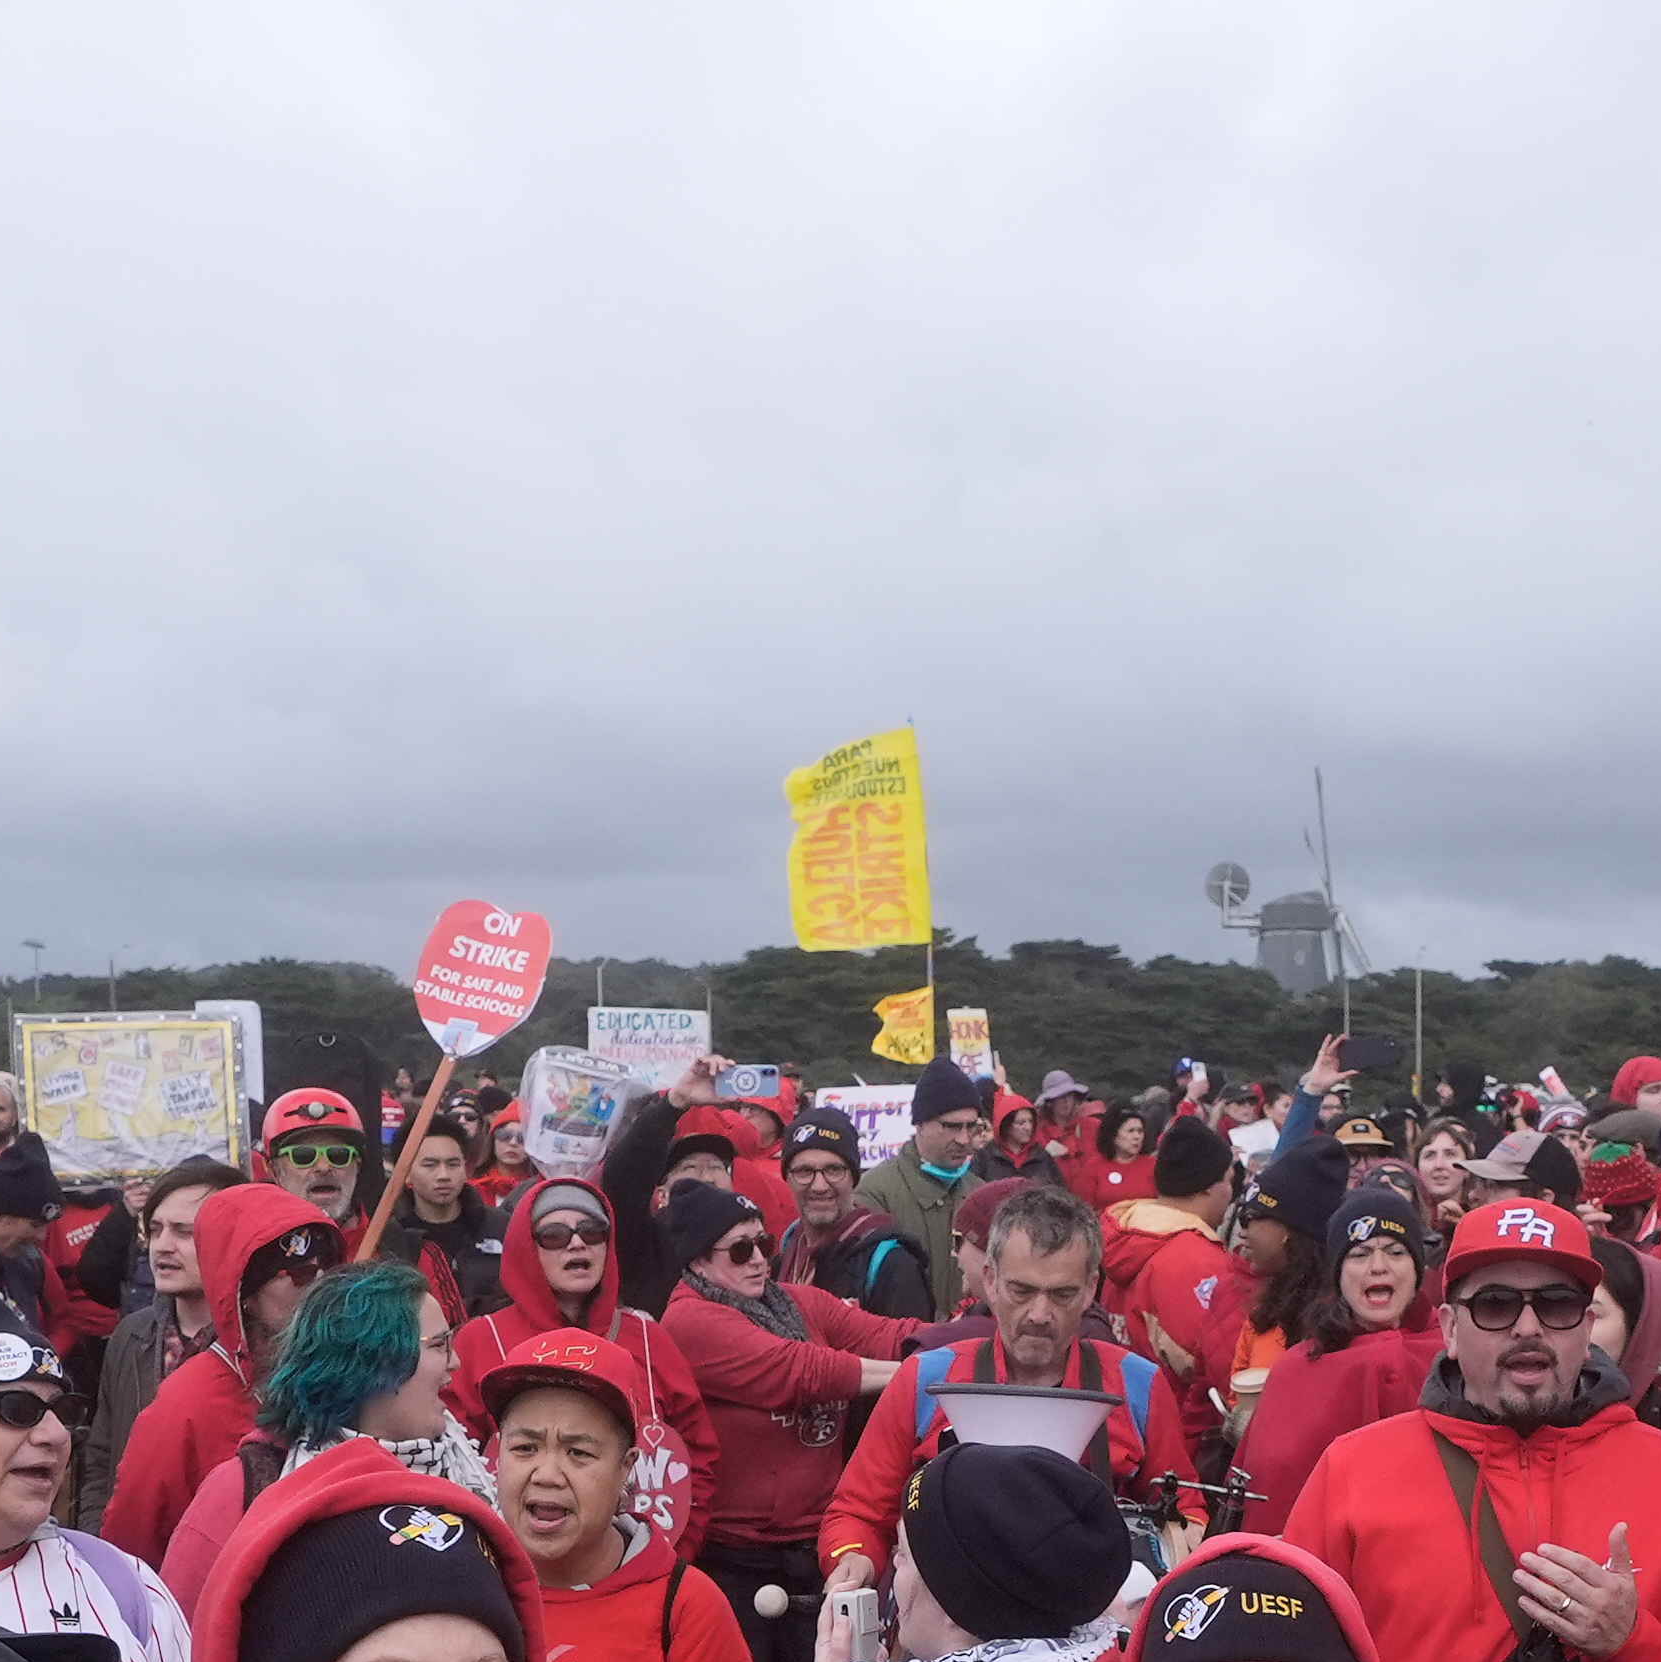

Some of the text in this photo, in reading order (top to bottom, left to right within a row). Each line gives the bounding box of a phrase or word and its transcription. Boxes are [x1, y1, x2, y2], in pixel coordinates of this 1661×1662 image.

[483, 912, 523, 938] ON
[448, 934, 530, 974] STRIKE
[413, 979, 525, 1018] STABLE SCHOOLS
[430, 964, 525, 1000] FOR SAFE AND
[1380, 1219, 1406, 1234] UESF
[1496, 1207, 1555, 1249] PR
[1239, 1590, 1304, 1620] UESF
